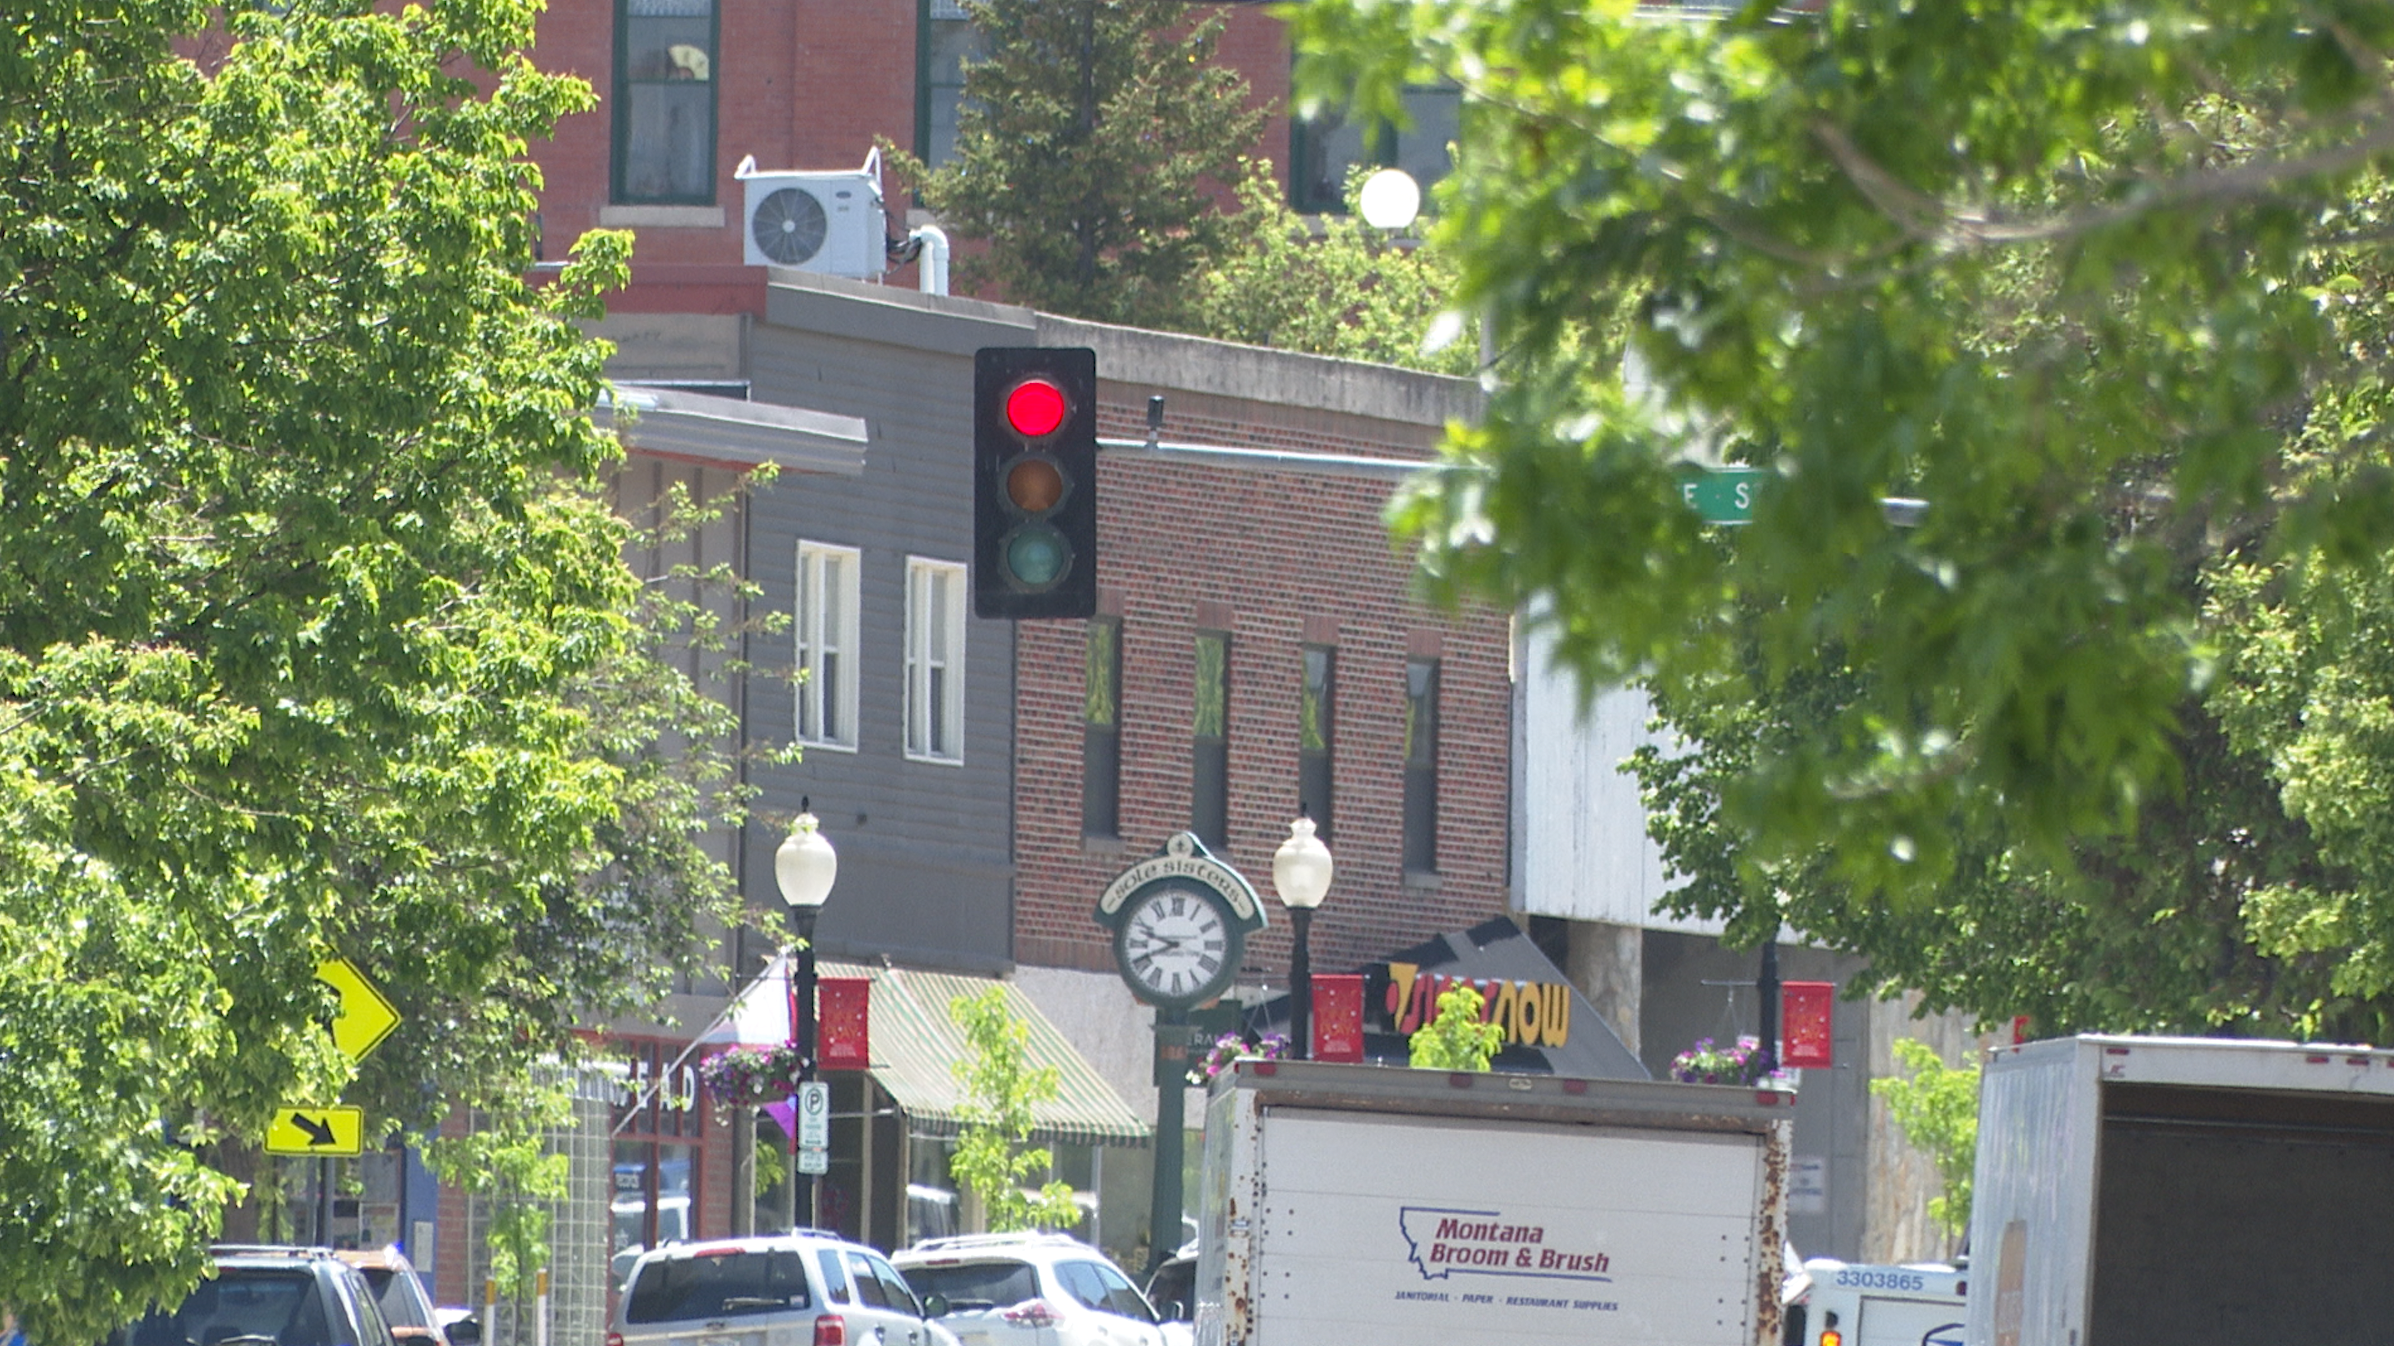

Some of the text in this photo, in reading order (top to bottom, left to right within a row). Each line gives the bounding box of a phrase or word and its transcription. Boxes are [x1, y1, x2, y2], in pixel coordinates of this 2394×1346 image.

[1436, 1218, 1544, 1244] Montana
[1430, 1243, 1610, 1273] Broom & Brush
[1836, 1270, 1924, 1291] 3303865
[1395, 1291, 1619, 1311] JANITORIAL PAPER RESTAURANT SUPPLIES
